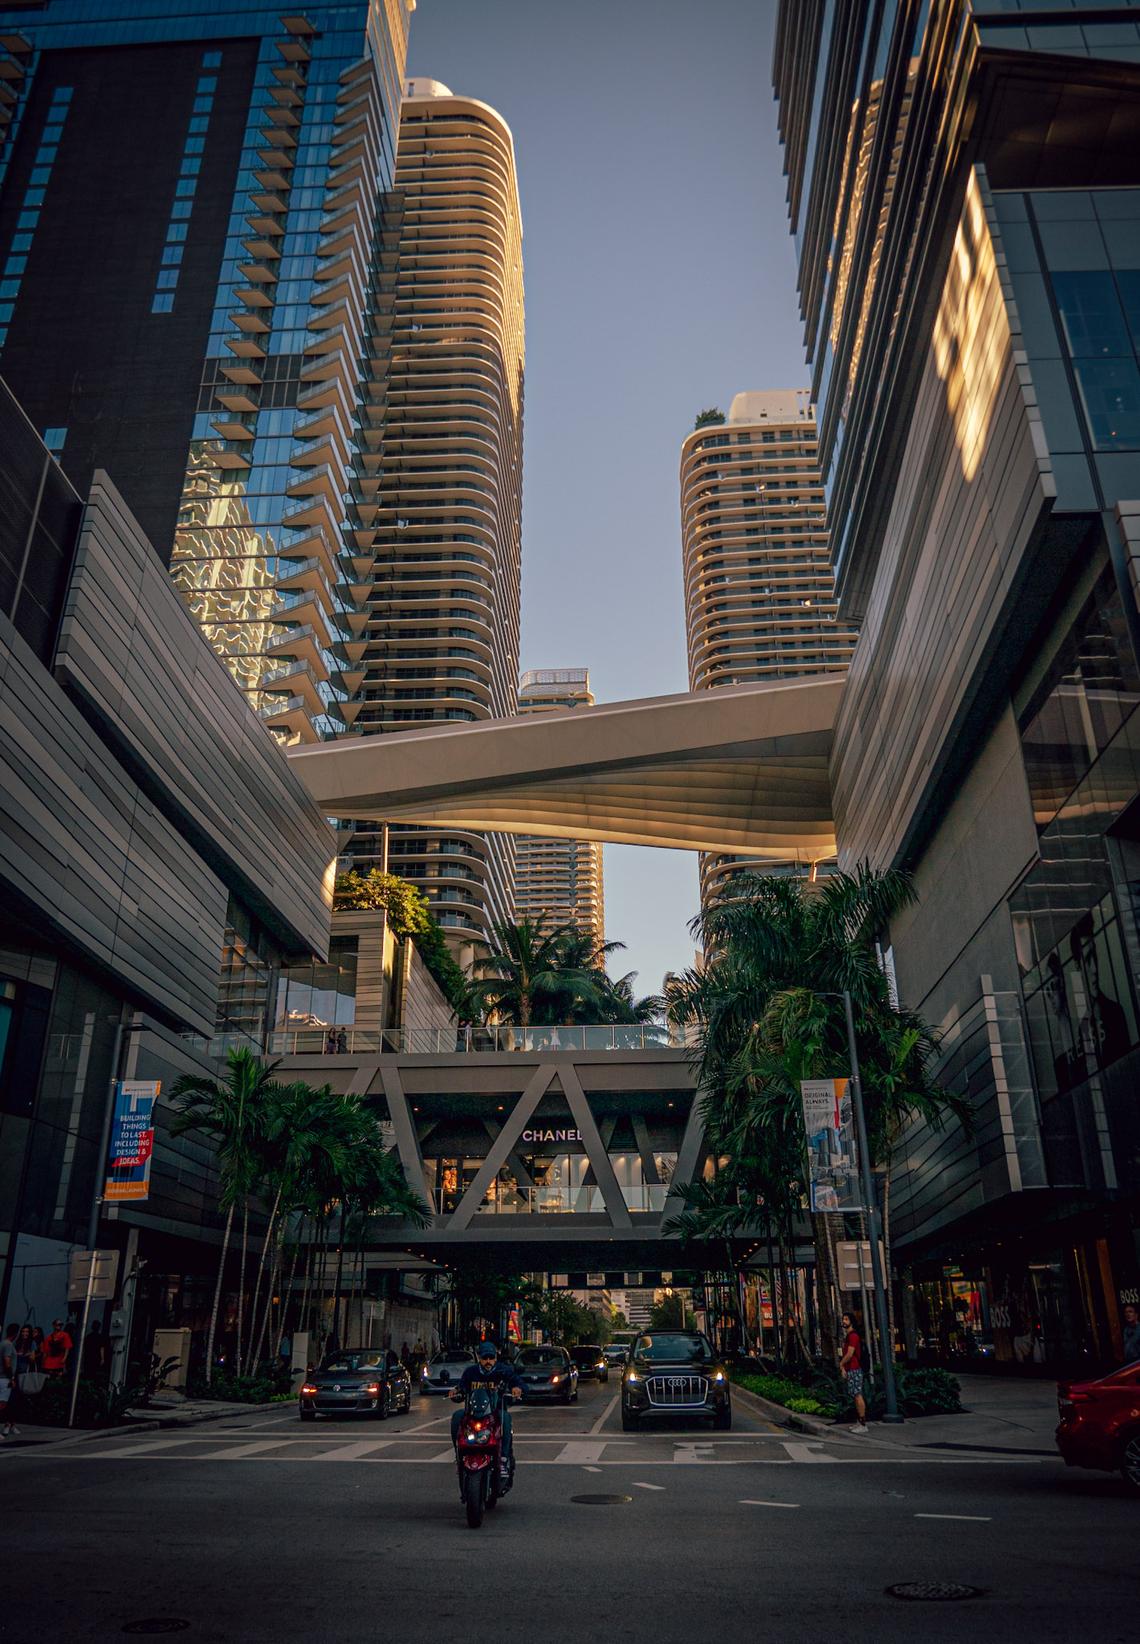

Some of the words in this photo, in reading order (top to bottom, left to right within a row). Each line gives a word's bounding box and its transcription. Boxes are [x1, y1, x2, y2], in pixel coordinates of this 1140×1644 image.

[120, 1114, 152, 1122] BUILDING
[522, 1129, 583, 1141] CHANEL
[114, 1139, 150, 1147] INCLUDING
[1120, 1288, 1140, 1304] BOSS
[989, 1305, 1011, 1328] BOSS
